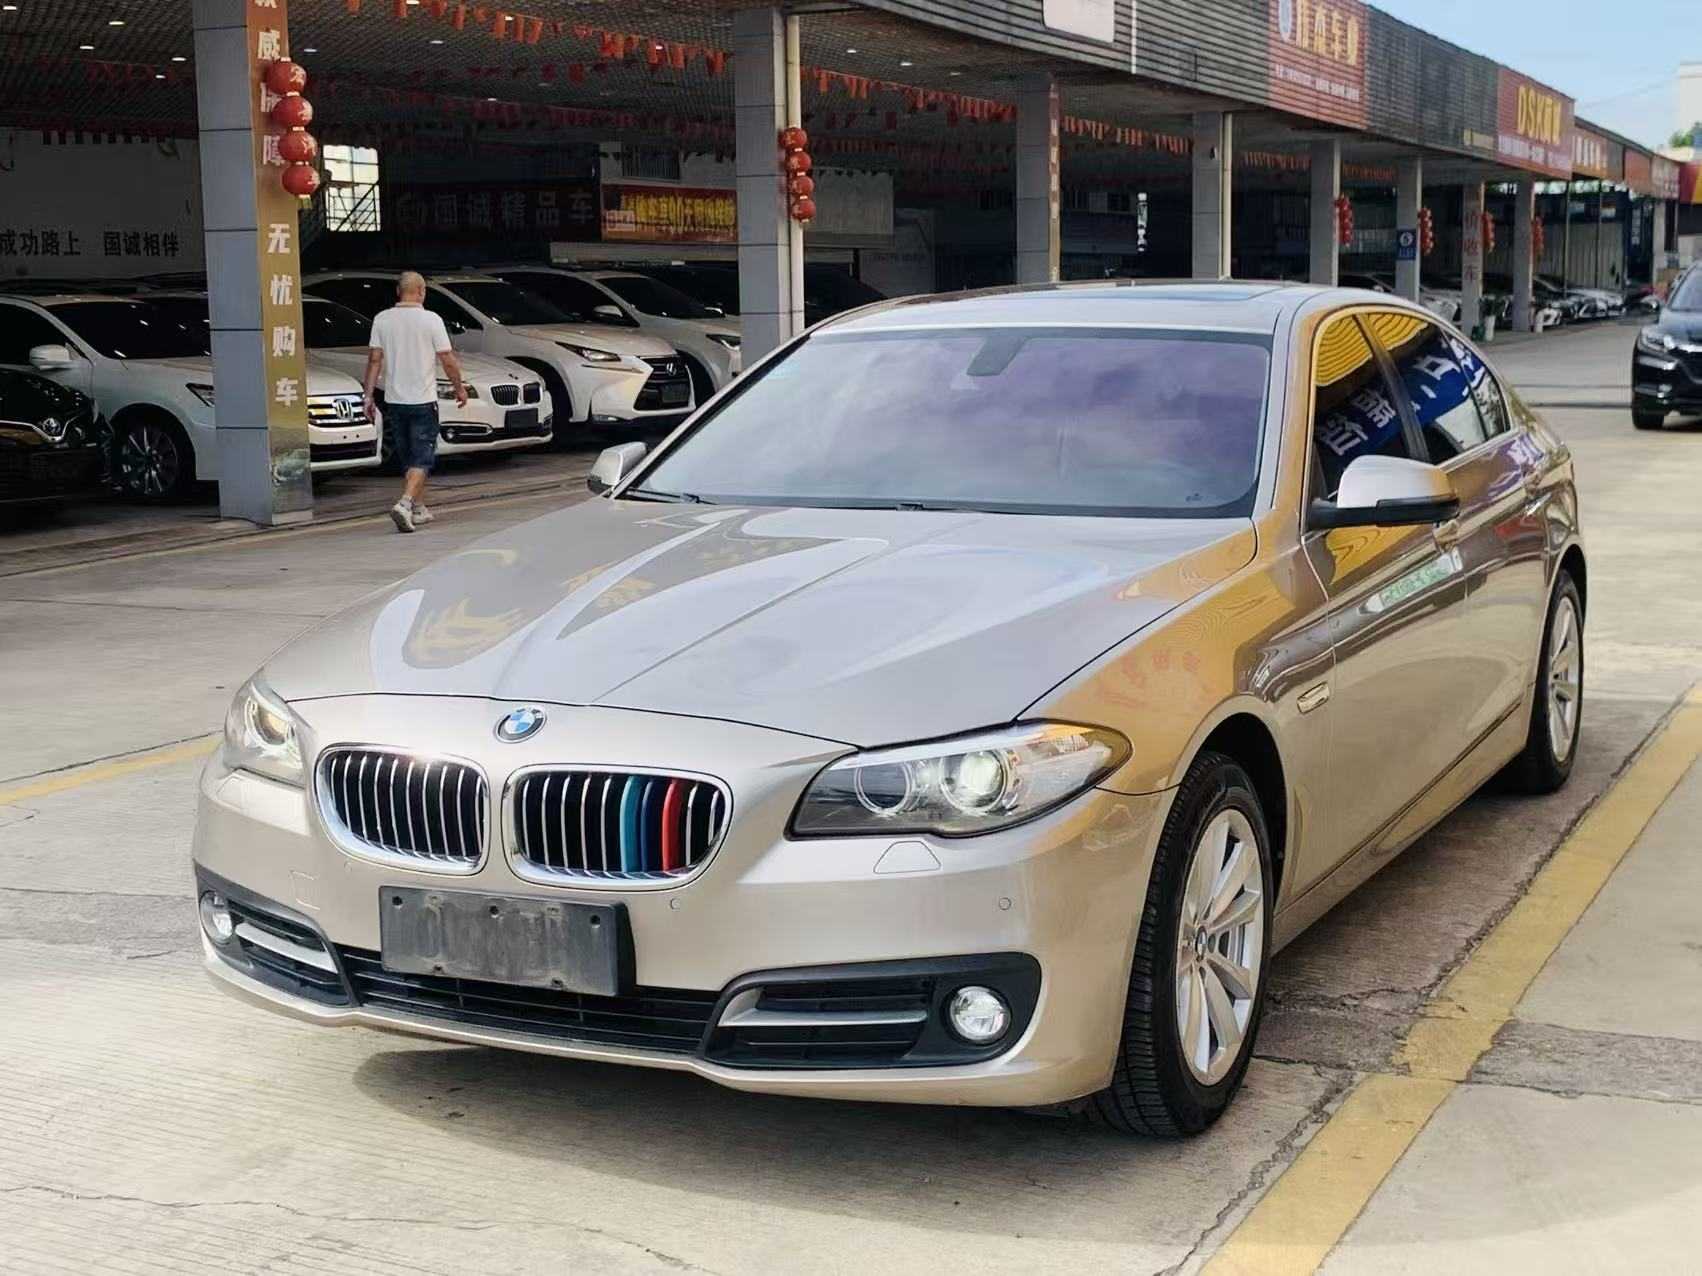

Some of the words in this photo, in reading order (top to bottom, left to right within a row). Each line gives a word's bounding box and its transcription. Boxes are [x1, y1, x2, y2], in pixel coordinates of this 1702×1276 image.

[0, 229, 81, 257] 成功路上
[103, 230, 180, 257] 国诚相伴
[267, 223, 300, 407] 无忧购车
